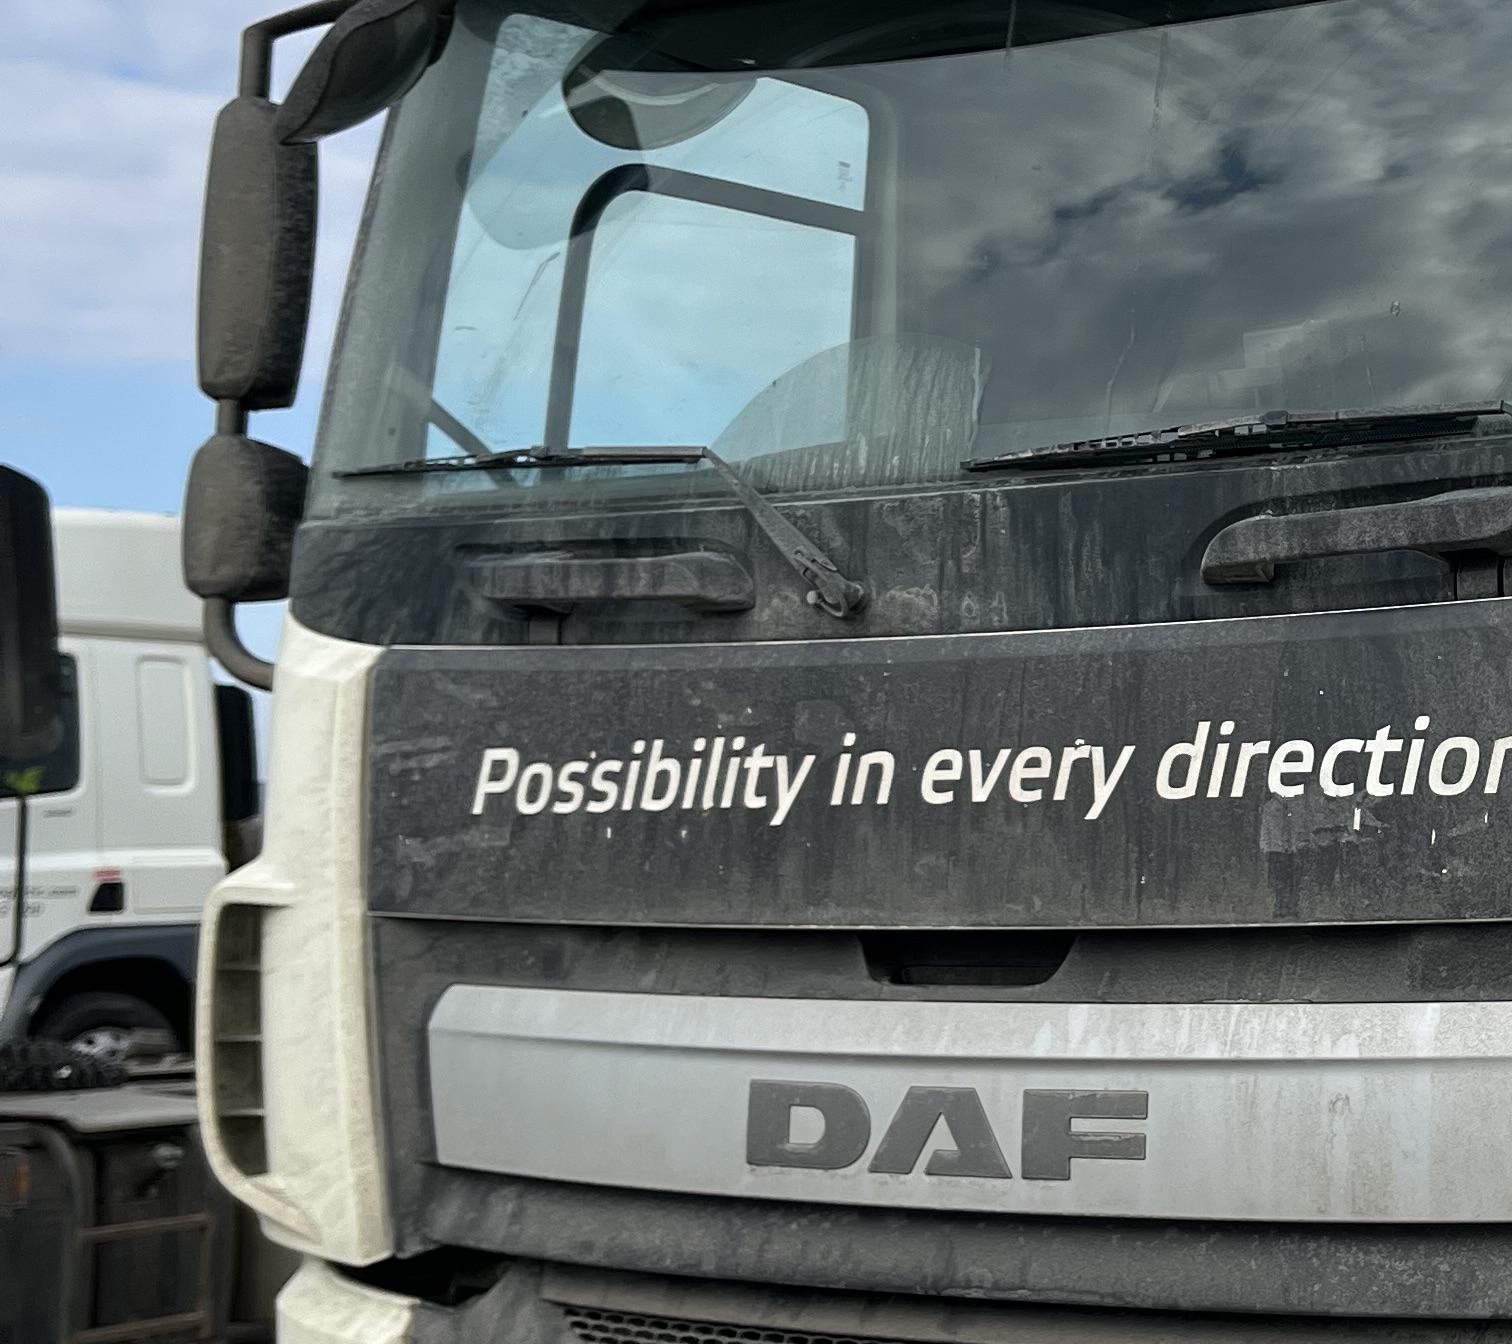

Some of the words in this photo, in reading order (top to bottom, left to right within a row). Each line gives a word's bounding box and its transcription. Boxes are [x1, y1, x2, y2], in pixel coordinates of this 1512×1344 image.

[470, 735, 816, 826] Possibility
[829, 732, 896, 806] in
[920, 742, 1136, 820] every
[745, 1078, 1149, 1181] DAF
